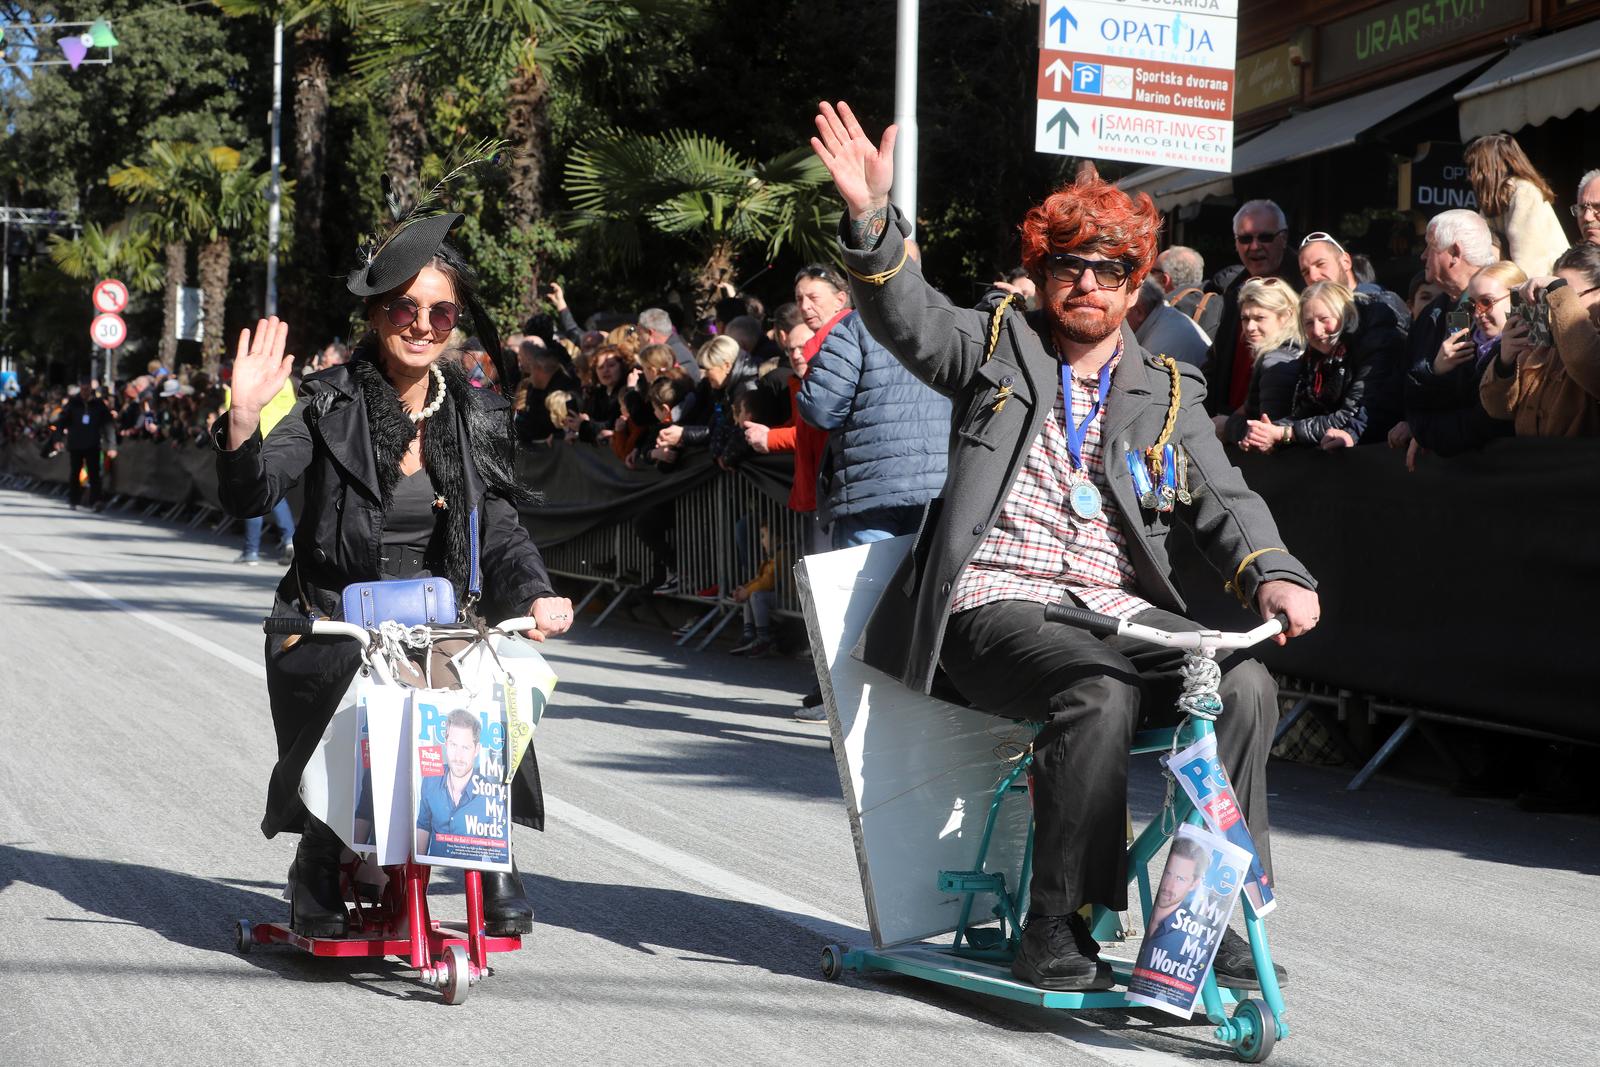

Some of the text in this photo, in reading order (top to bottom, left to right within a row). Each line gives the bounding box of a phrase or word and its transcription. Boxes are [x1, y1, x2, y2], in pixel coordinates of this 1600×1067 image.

[1135, 68, 1229, 92] Sportska dvorana
[1135, 88, 1226, 112] Marino Cvetković
[1105, 114, 1227, 142] SMART-INVEST
[100, 323, 118, 337] 30
[418, 703, 505, 750] Pele
[471, 774, 507, 802] Story,
[1170, 908, 1218, 946] Story,
